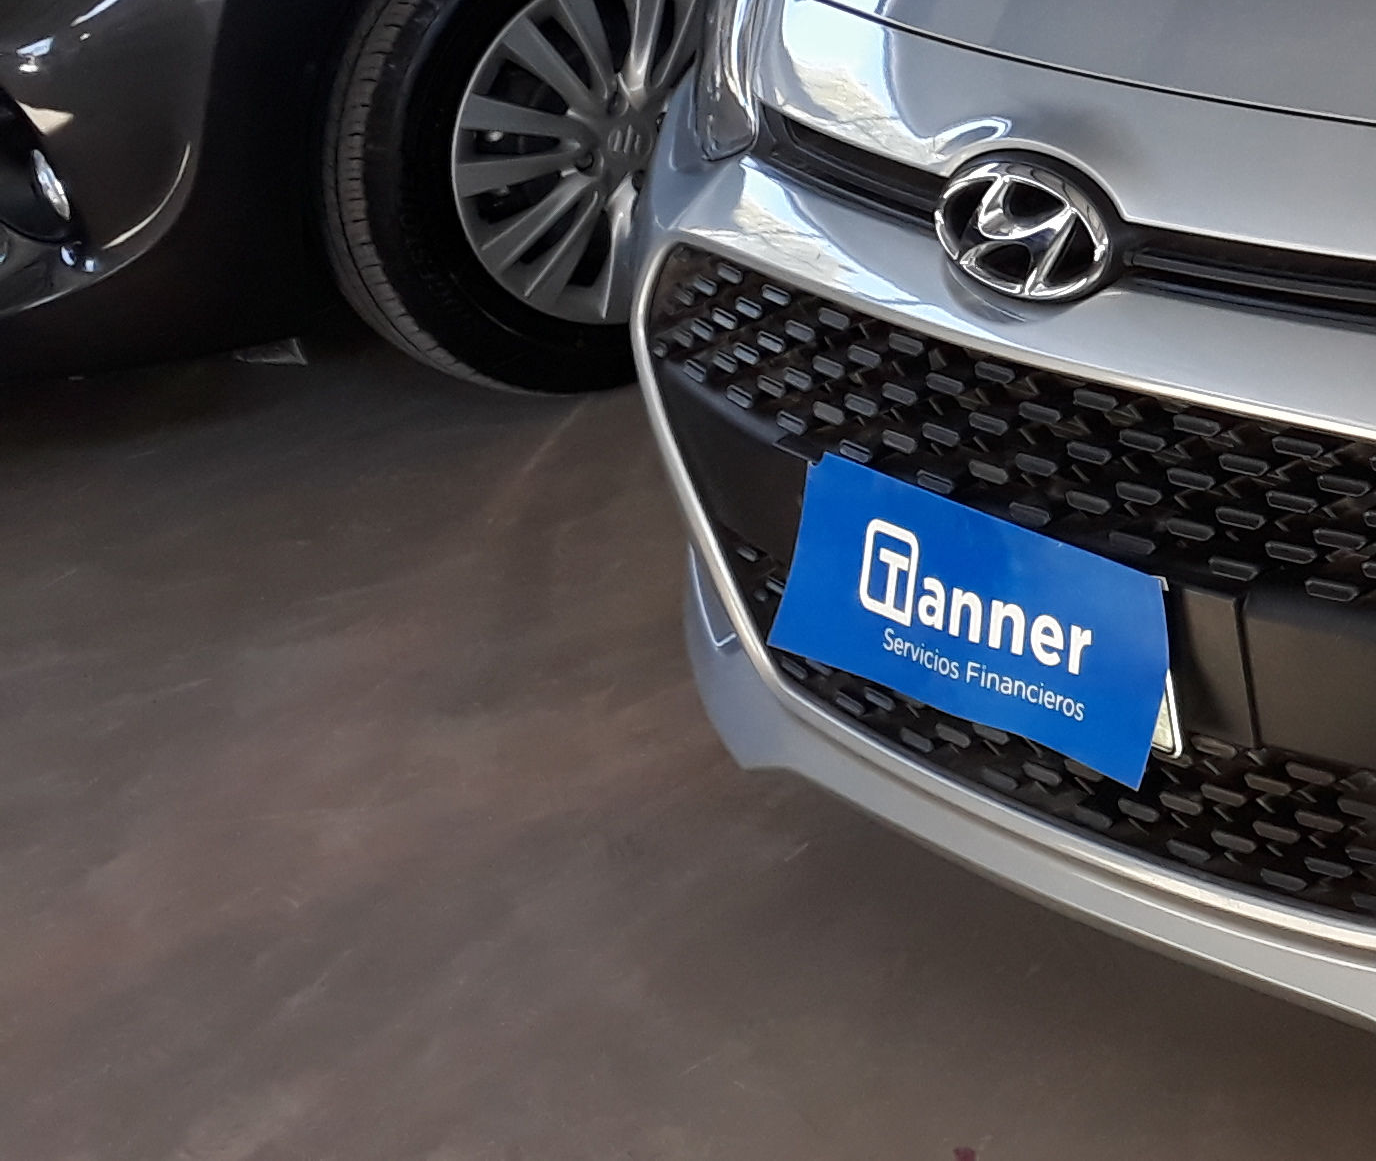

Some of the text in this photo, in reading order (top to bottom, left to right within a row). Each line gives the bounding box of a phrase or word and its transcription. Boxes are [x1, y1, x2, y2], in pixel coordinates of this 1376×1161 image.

[859, 517, 1093, 677] Tanner
[881, 626, 1086, 723] Servicios Financieros
